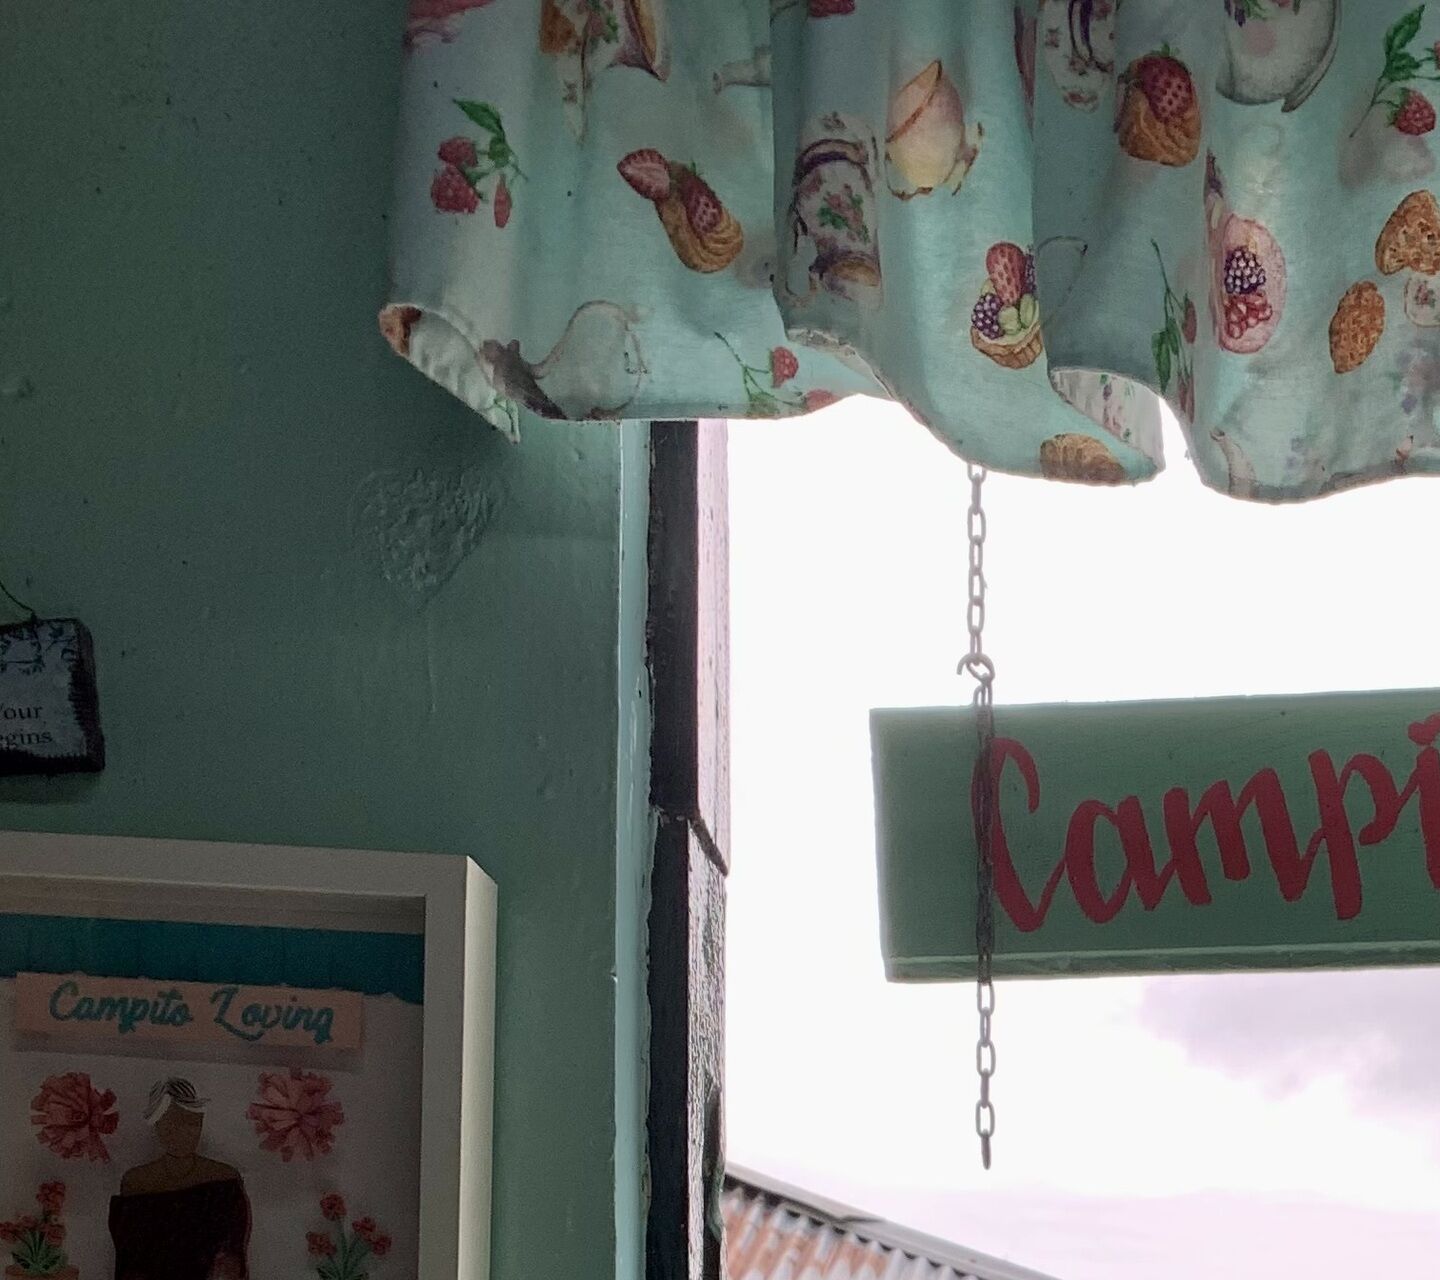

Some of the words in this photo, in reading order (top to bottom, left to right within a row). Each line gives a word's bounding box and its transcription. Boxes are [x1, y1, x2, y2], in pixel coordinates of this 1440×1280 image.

[0, 702, 43, 720] our
[48, 980, 194, 1035] Campito
[209, 983, 335, 1045] Loving
